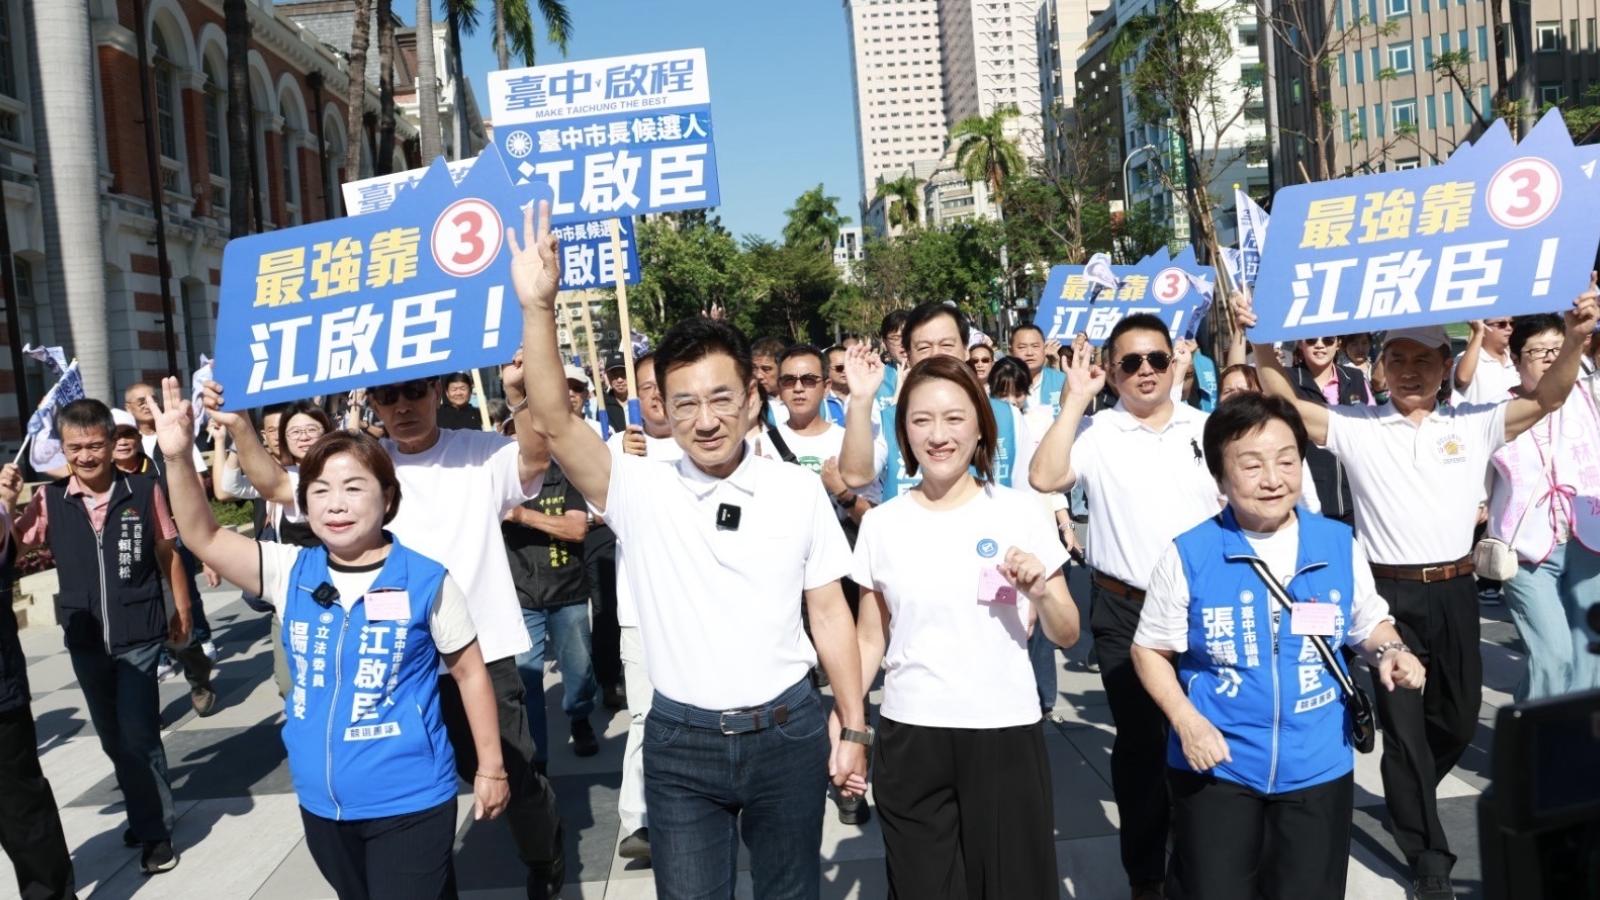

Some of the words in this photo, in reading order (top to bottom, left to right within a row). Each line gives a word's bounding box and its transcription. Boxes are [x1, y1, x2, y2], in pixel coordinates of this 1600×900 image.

[535, 108, 564, 119] MAKE
[566, 103, 618, 116] TAICHUNG
[620, 101, 640, 109] THE
[641, 96, 668, 107] BEST
[538, 113, 708, 154] 臺中市長候選人
[516, 143, 709, 216] 江啟臣
[1298, 181, 1477, 251] 最強靠
[1508, 169, 1542, 218] 3
[253, 226, 421, 308] 最強靠
[448, 210, 485, 266] 3
[558, 240, 631, 287] 啟臣
[1161, 273, 1180, 298] 3
[312, 626, 331, 688] 立法委員
[351, 625, 391, 723] 江啟臣
